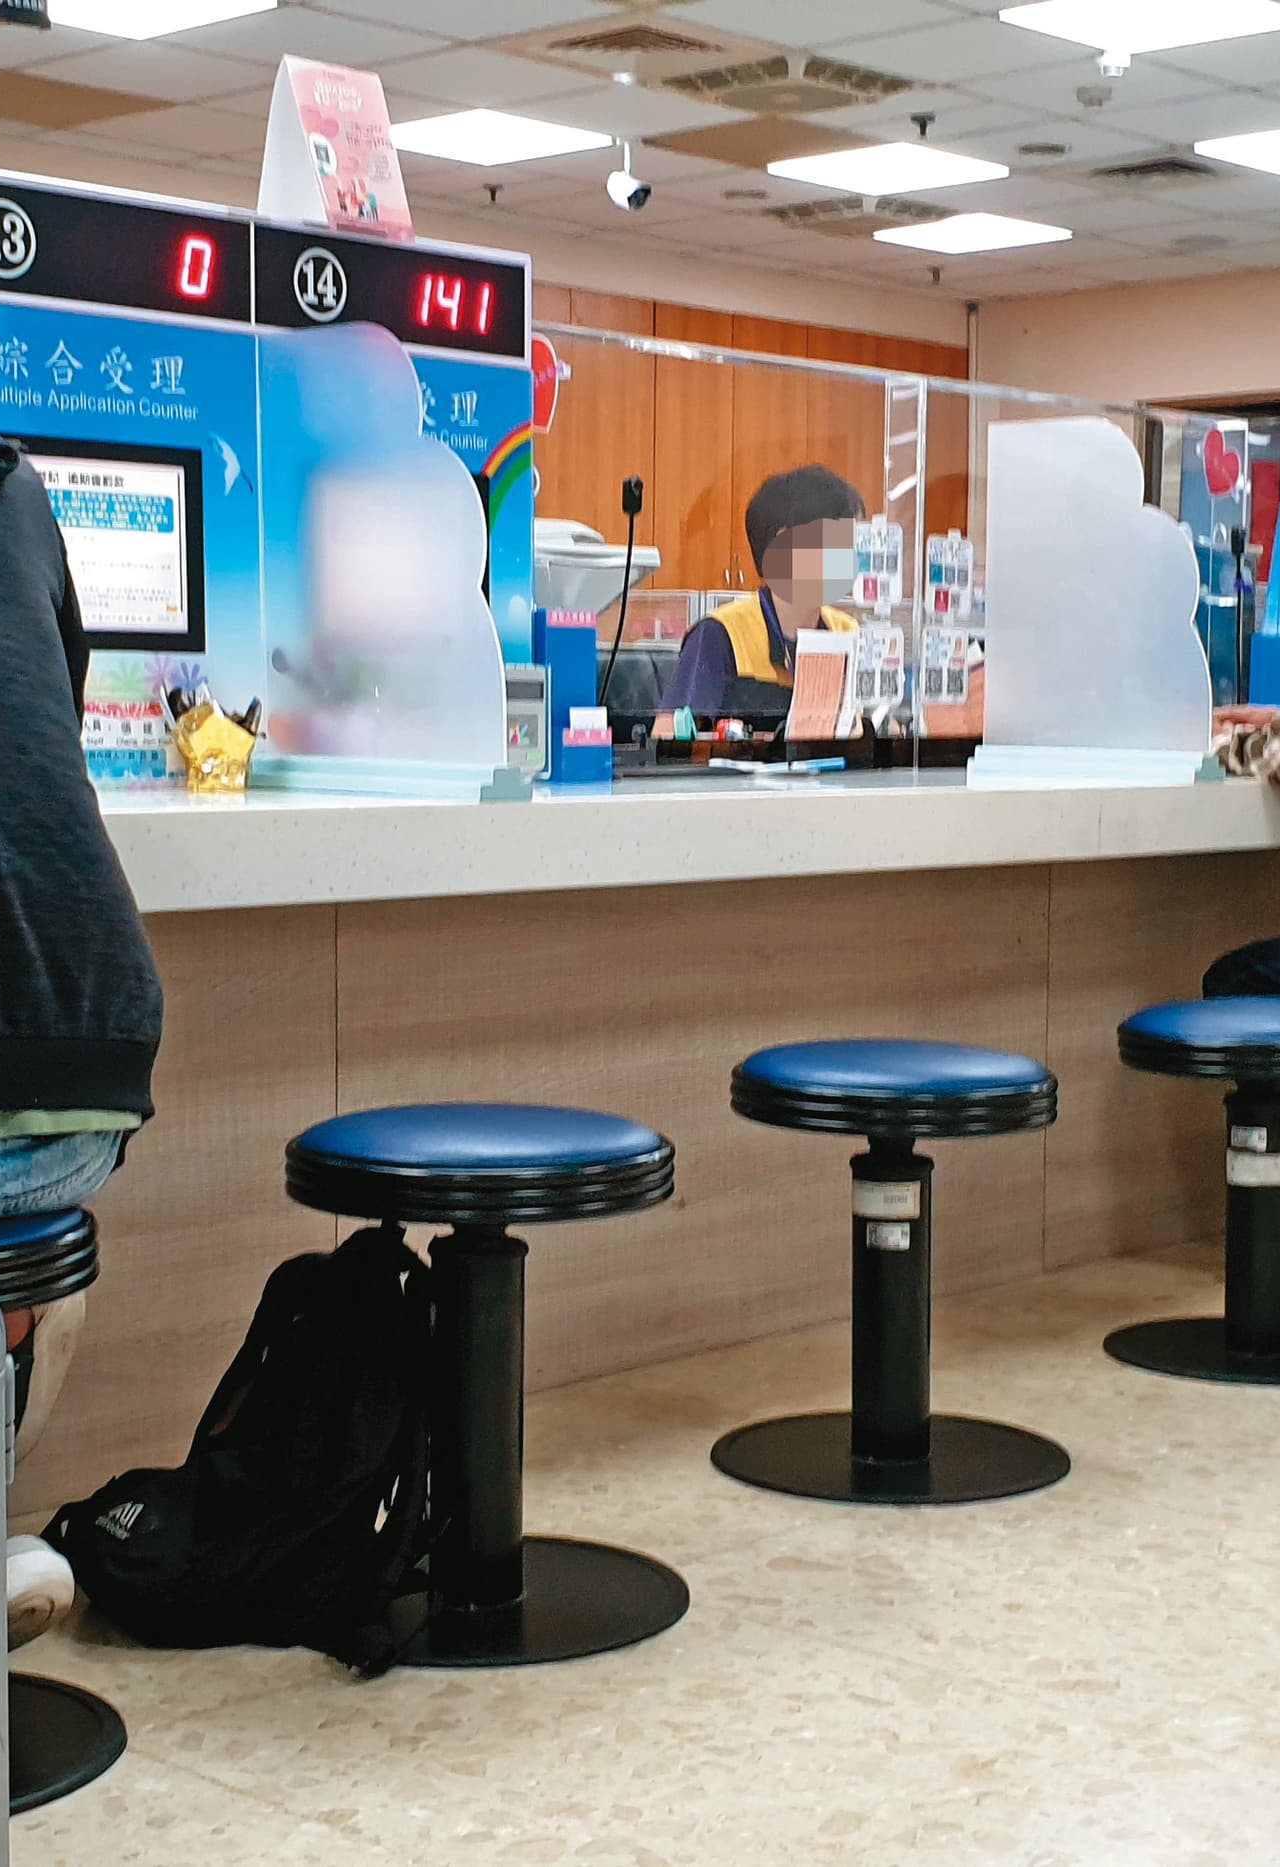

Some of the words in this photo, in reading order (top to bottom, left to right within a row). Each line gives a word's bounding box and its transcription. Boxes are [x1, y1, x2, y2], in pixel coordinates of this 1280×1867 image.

[179, 236, 214, 297] 0
[298, 253, 342, 314] 14
[419, 272, 494, 335] 141
[48, 389, 136, 415] Application
[139, 397, 199, 421] Counter
[441, 428, 488, 452] Counter
